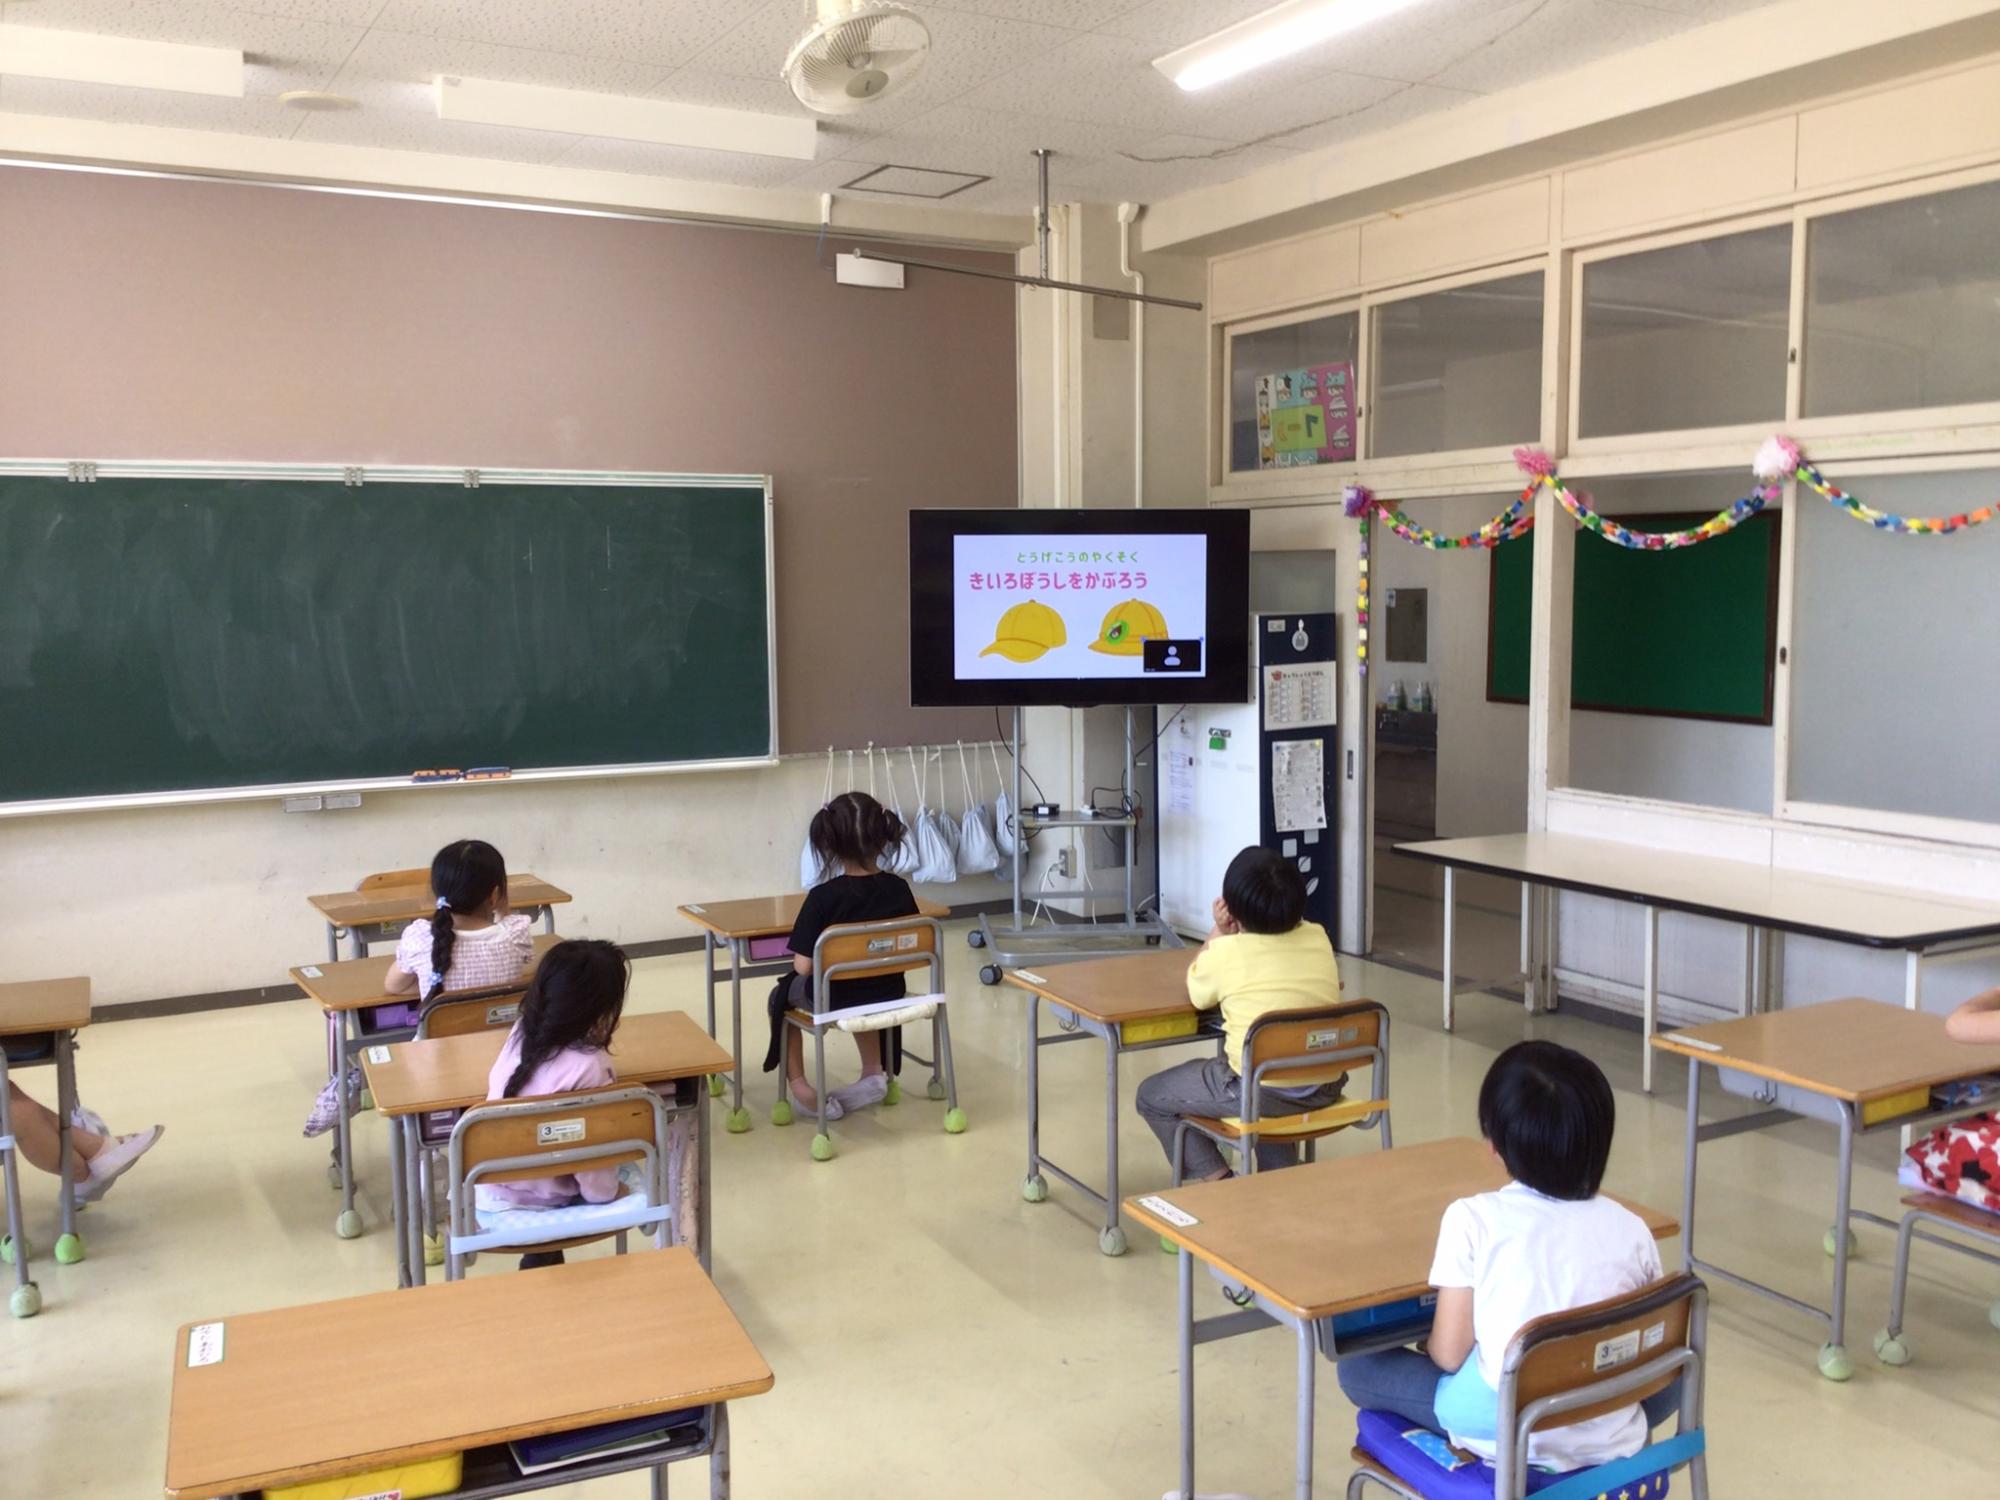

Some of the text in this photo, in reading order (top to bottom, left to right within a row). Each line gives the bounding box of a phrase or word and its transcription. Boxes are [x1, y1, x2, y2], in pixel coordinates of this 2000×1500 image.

[1017, 552, 1139, 563] とうげこうのやくそく
[969, 572, 1148, 590] きいろぼうしをかぶろう
[544, 1126, 552, 1136] 3
